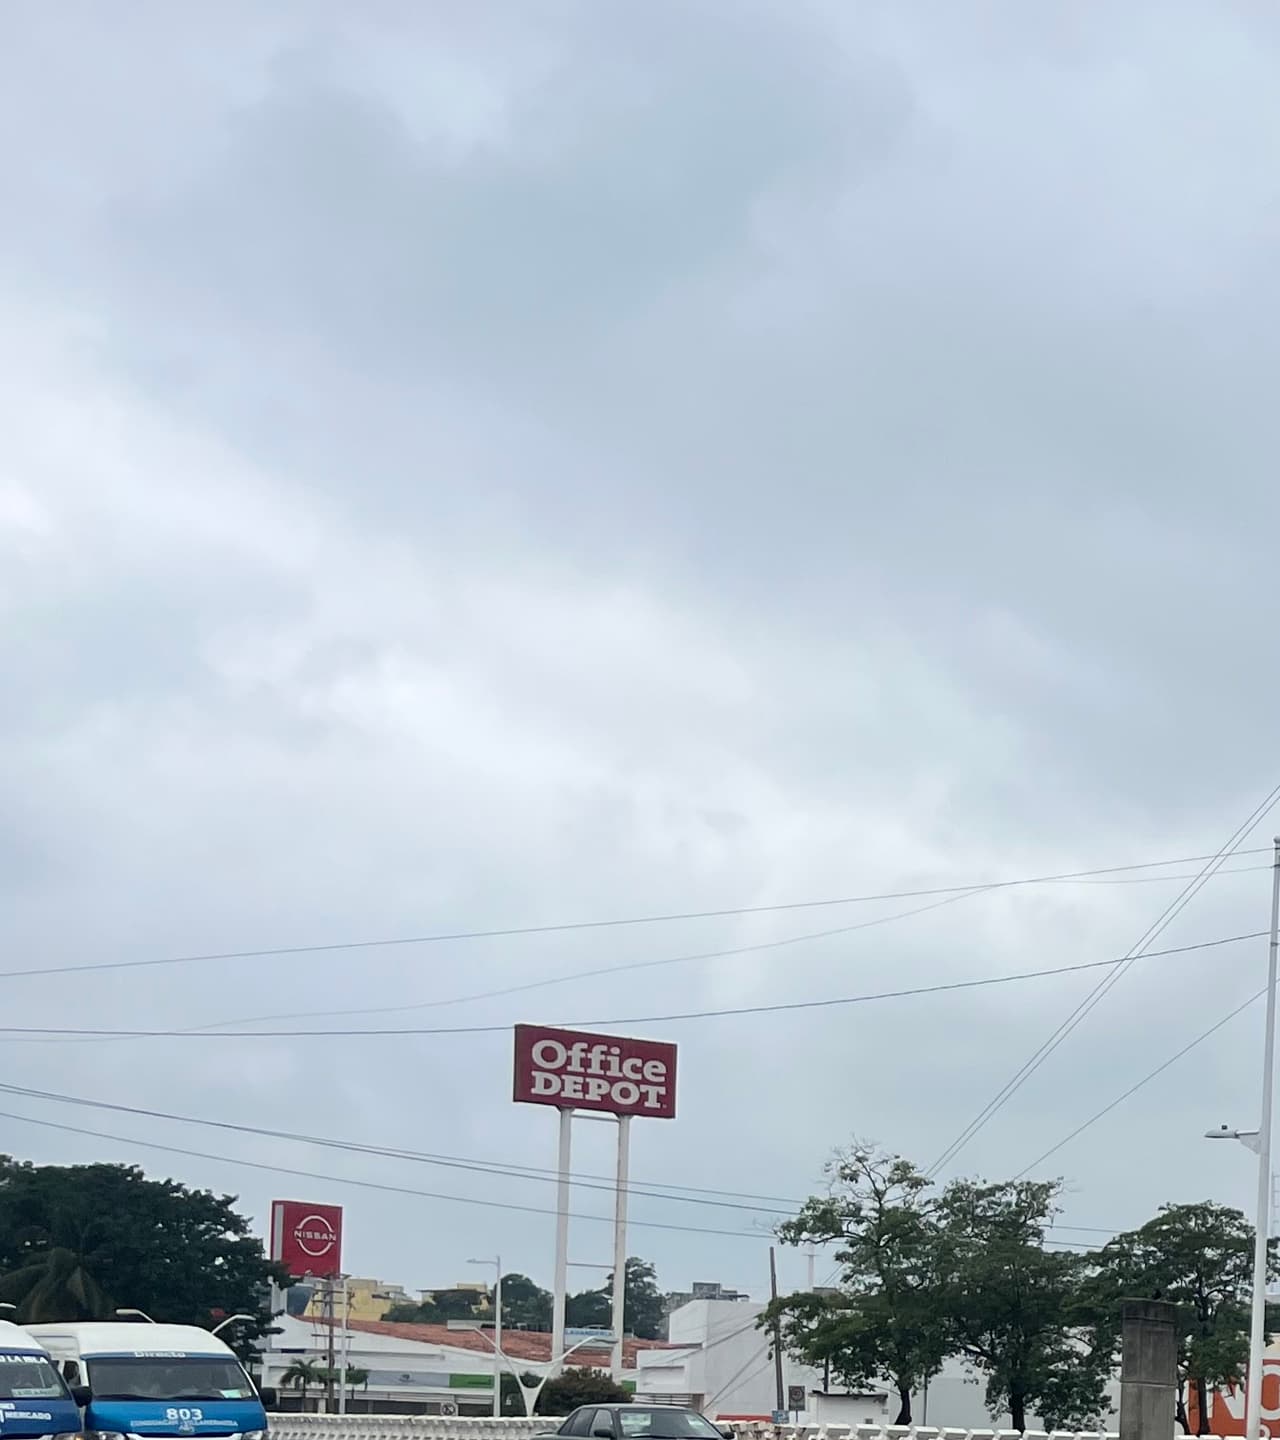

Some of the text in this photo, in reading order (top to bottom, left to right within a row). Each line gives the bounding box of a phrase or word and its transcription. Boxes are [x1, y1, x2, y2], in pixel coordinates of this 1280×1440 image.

[531, 1039, 667, 1082] Office
[531, 1070, 667, 1108] DEPOT
[294, 1230, 337, 1241] NISSAN
[166, 1408, 202, 1420] 803
